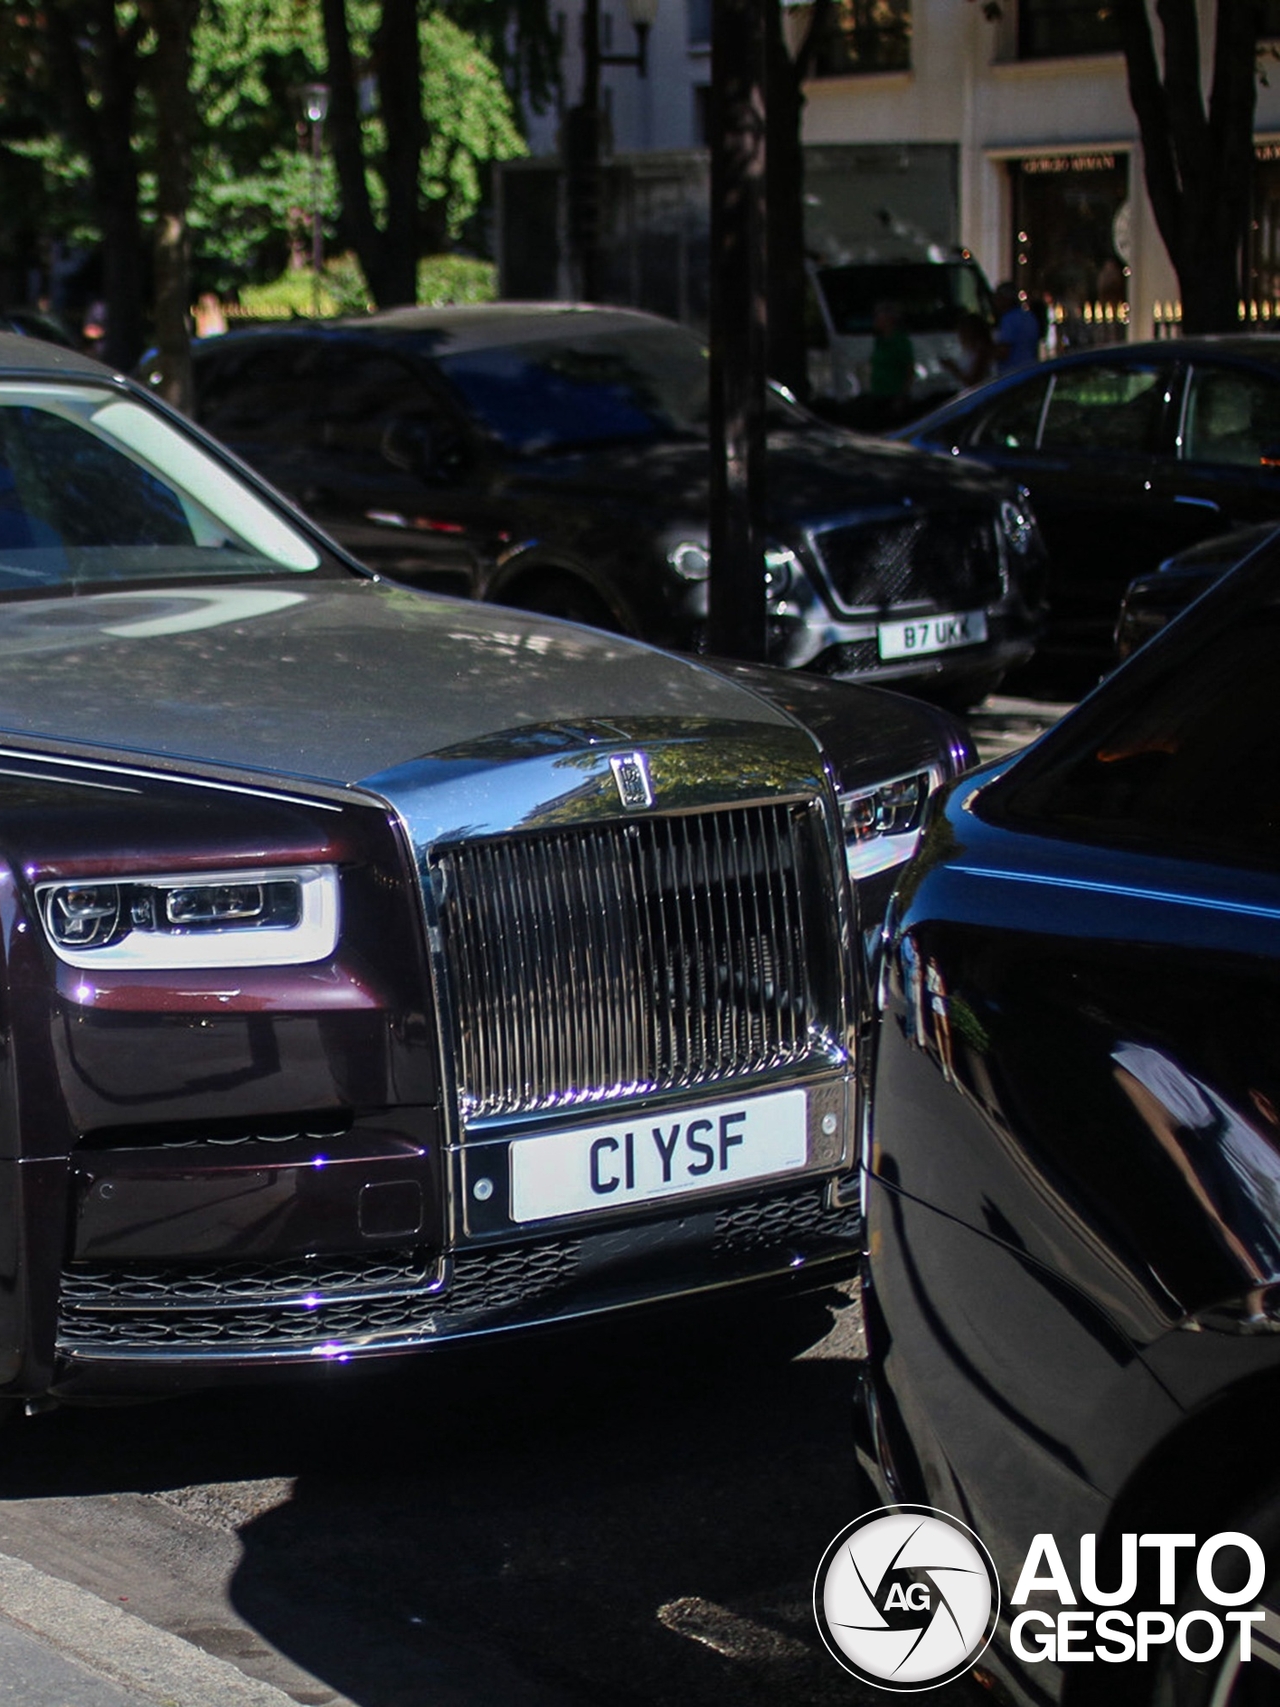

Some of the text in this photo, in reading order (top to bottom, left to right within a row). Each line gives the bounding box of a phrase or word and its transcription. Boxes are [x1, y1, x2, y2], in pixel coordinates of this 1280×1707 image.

[1071, 155, 1116, 171] ARMANI
[904, 623, 929, 649] B7
[652, 1111, 746, 1183] YSF
